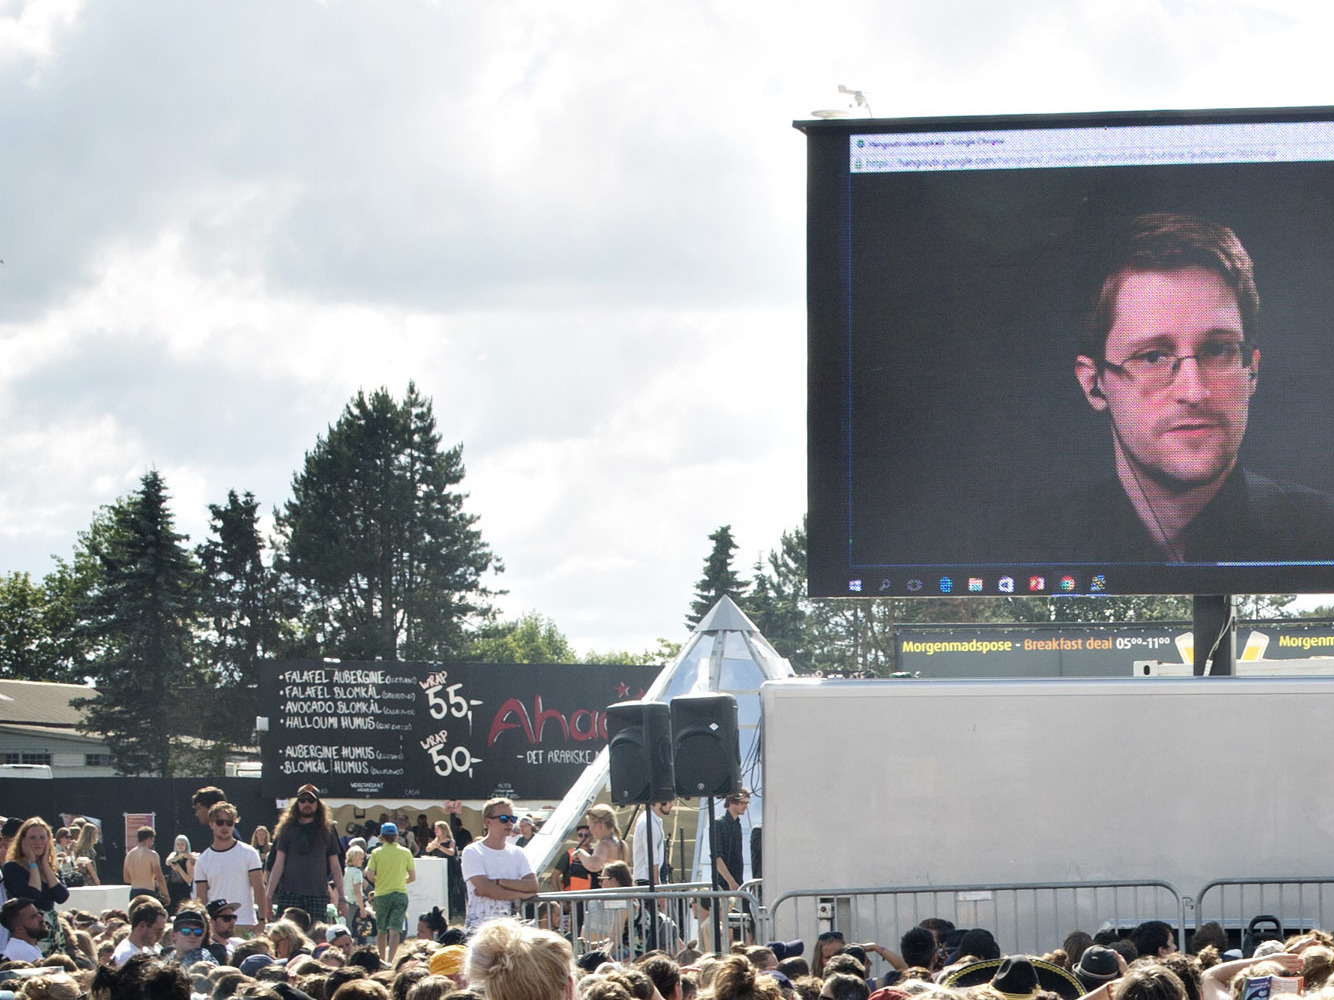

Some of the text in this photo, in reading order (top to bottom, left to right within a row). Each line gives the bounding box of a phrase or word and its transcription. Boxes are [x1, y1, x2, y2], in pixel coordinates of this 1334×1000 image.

[902, 639, 1012, 656] Morgenmadspose
[1023, 637, 1083, 651] Breakfast
[1086, 636, 1112, 650] deal
[285, 670, 329, 684] FALAFEL
[333, 669, 386, 684] AUBERGINE
[419, 671, 447, 690] WRAP
[285, 685, 331, 699] FALAFEL
[334, 684, 381, 699] BLOMKÅL
[285, 701, 335, 714] AVOCADO
[337, 700, 382, 714] BLOMKÅL
[286, 716, 338, 729] HALLOUMI
[340, 716, 376, 730] HUMUS
[487, 693, 607, 748] Aha
[420, 730, 448, 750] WRAP
[285, 744, 339, 759] AUBERGINE
[341, 746, 375, 760] HUMUS
[527, 751, 543, 765] DET
[547, 750, 592, 765] ARABISKE
[334, 761, 369, 774] HUMUS
